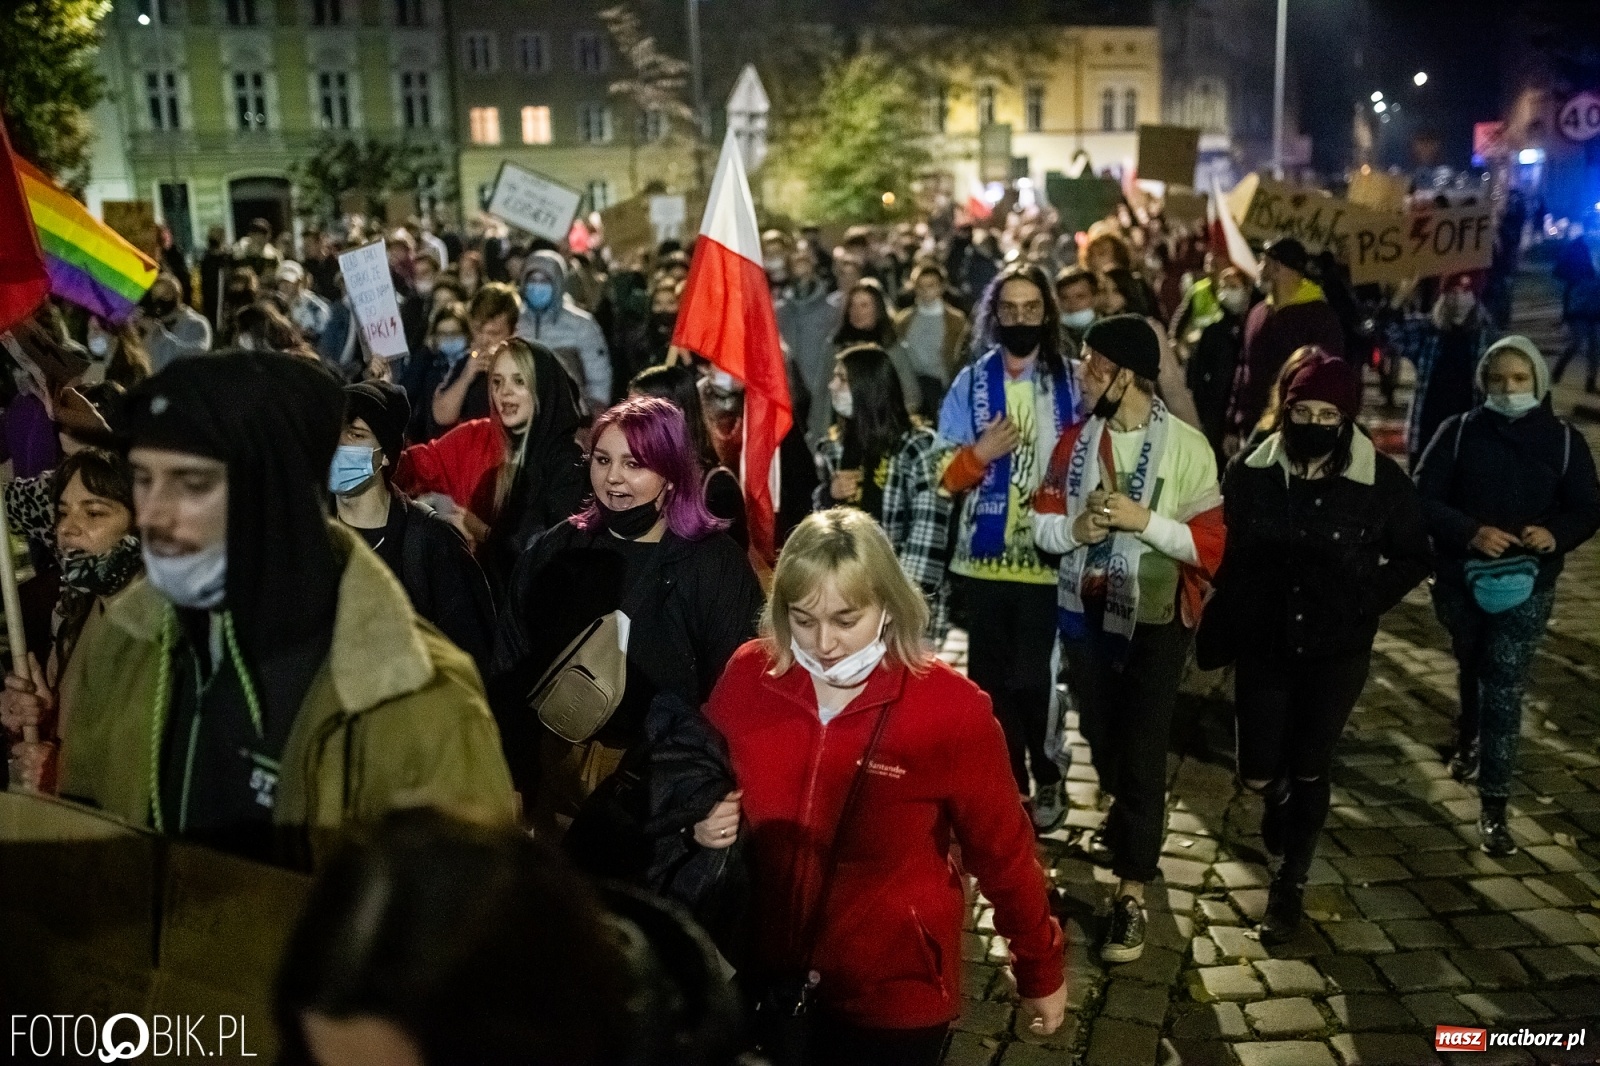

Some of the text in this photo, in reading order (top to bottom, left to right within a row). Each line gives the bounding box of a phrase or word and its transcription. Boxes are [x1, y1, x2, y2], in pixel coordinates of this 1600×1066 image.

[1562, 103, 1600, 129] 40
[1434, 214, 1489, 257] OFF
[362, 320, 390, 341] IPKI
[868, 760, 907, 775] Santander
